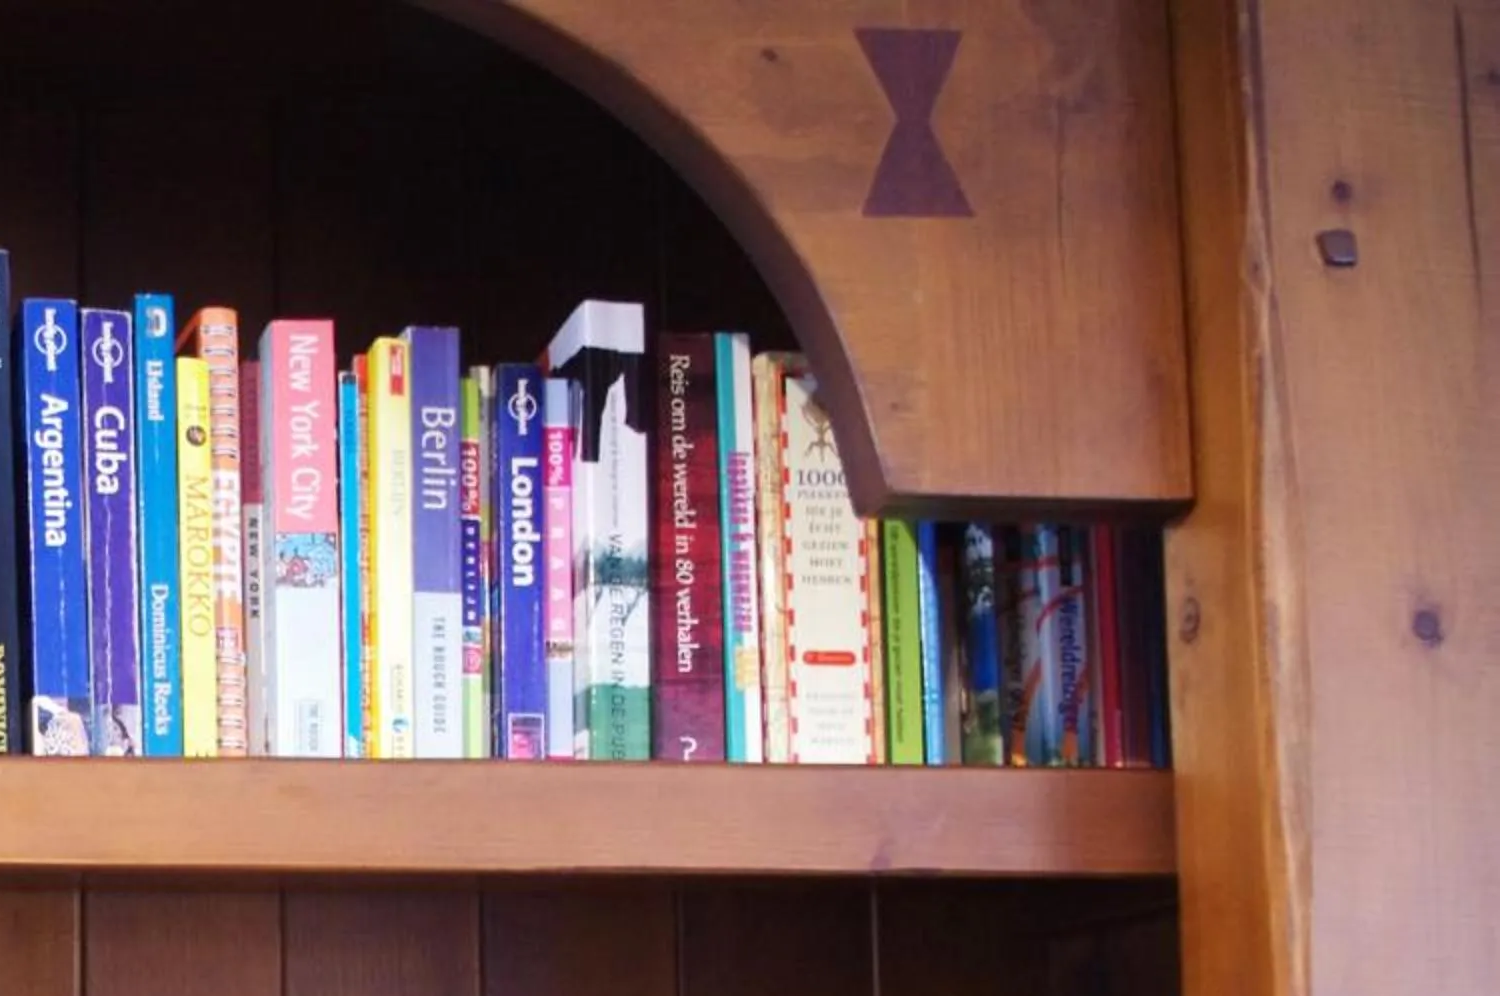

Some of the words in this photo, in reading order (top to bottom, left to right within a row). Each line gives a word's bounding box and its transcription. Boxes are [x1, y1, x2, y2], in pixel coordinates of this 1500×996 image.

[289, 333, 320, 392] New
[669, 354, 691, 395] Reis
[290, 400, 320, 459] York
[670, 398, 685, 432] om
[35, 393, 72, 547] Argentina
[94, 404, 126, 496] Cuba
[421, 405, 456, 510] Berlin
[547, 430, 565, 486] 100%
[672, 435, 693, 460] de
[285, 466, 323, 519] City
[461, 445, 479, 512] 100%
[673, 463, 697, 529] wereld
[248, 517, 259, 557] NEW
[510, 456, 542, 588] London
[675, 535, 695, 554] in
[184, 473, 213, 639] MAROKKO
[676, 559, 695, 585] 80
[249, 570, 261, 620] YORK
[150, 584, 169, 679] Dominicus
[609, 603, 624, 666] REGEN
[676, 588, 701, 673] verhalen
[153, 682, 173, 736] Reeks
